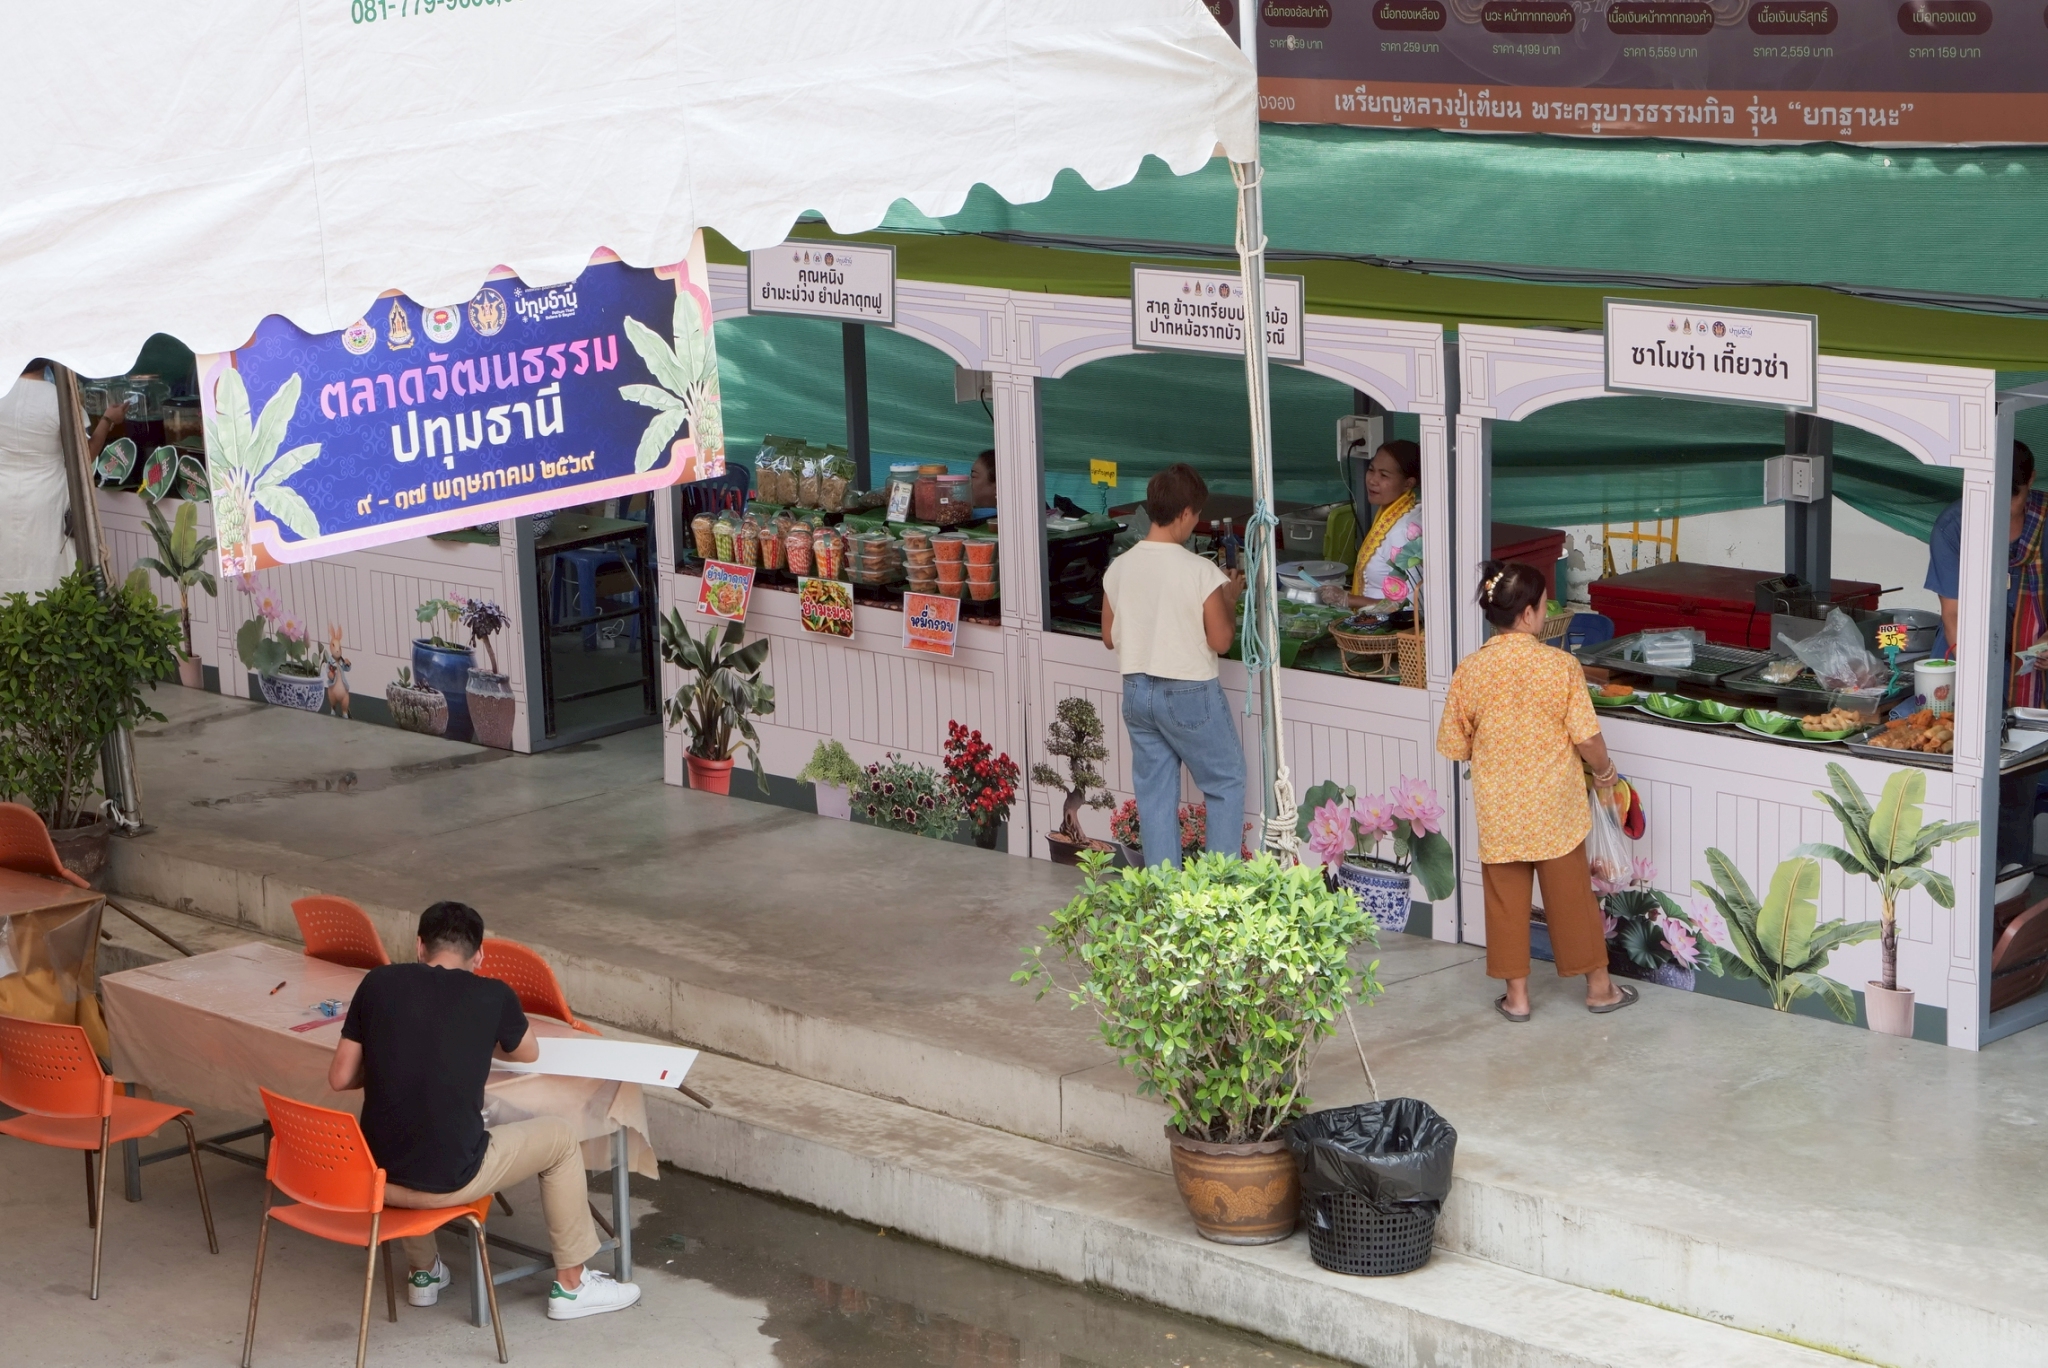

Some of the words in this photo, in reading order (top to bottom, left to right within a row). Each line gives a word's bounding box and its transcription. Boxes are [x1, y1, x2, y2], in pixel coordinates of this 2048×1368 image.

[1380, 4, 1440, 21] เนื้อทองเหลือง
[1911, 5, 1977, 23] เนื้อทองแดง
[1306, 41, 1323, 50] บาท
[1380, 42, 1401, 52] ราคา
[1403, 42, 1421, 53] 259
[1422, 43, 1440, 53] บาท
[1492, 44, 1515, 55] ราคา
[1516, 44, 1540, 56] 4,199
[1542, 45, 1561, 55] บาท
[1623, 47, 1647, 57] ราคา
[1648, 47, 1677, 59] 5,559
[1678, 47, 1698, 58] บาท
[1753, 46, 1778, 58] ราคา
[1780, 46, 1811, 59] 2,559
[1813, 47, 1834, 58] บาท
[1909, 47, 1935, 58] ราคา
[1937, 47, 1957, 58] 159
[1959, 47, 1981, 58] บาท
[1334, 84, 1522, 128] เหรียญหลวงปู่เทียน
[1532, 96, 1735, 133] พระครูบวรธรรมกิจ
[1746, 95, 1778, 137] รุ่น
[798, 269, 844, 287] คุณหนิง
[762, 282, 815, 303] ยำมะม่วง
[818, 287, 882, 314] ยำปลาดุกฟู
[1146, 300, 1170, 320] สาคู
[1631, 340, 1705, 371] ซาโมซ่า
[1714, 342, 1789, 379] เกี๊ยวซ่า
[319, 334, 620, 420] ตลาดวัฒนธรรม
[391, 381, 564, 470] ปทุมธานี
[433, 463, 535, 505] พฤษภาคม
[802, 596, 853, 622] ยำมะม่วง
[910, 603, 954, 633] หมี่กรอบ
